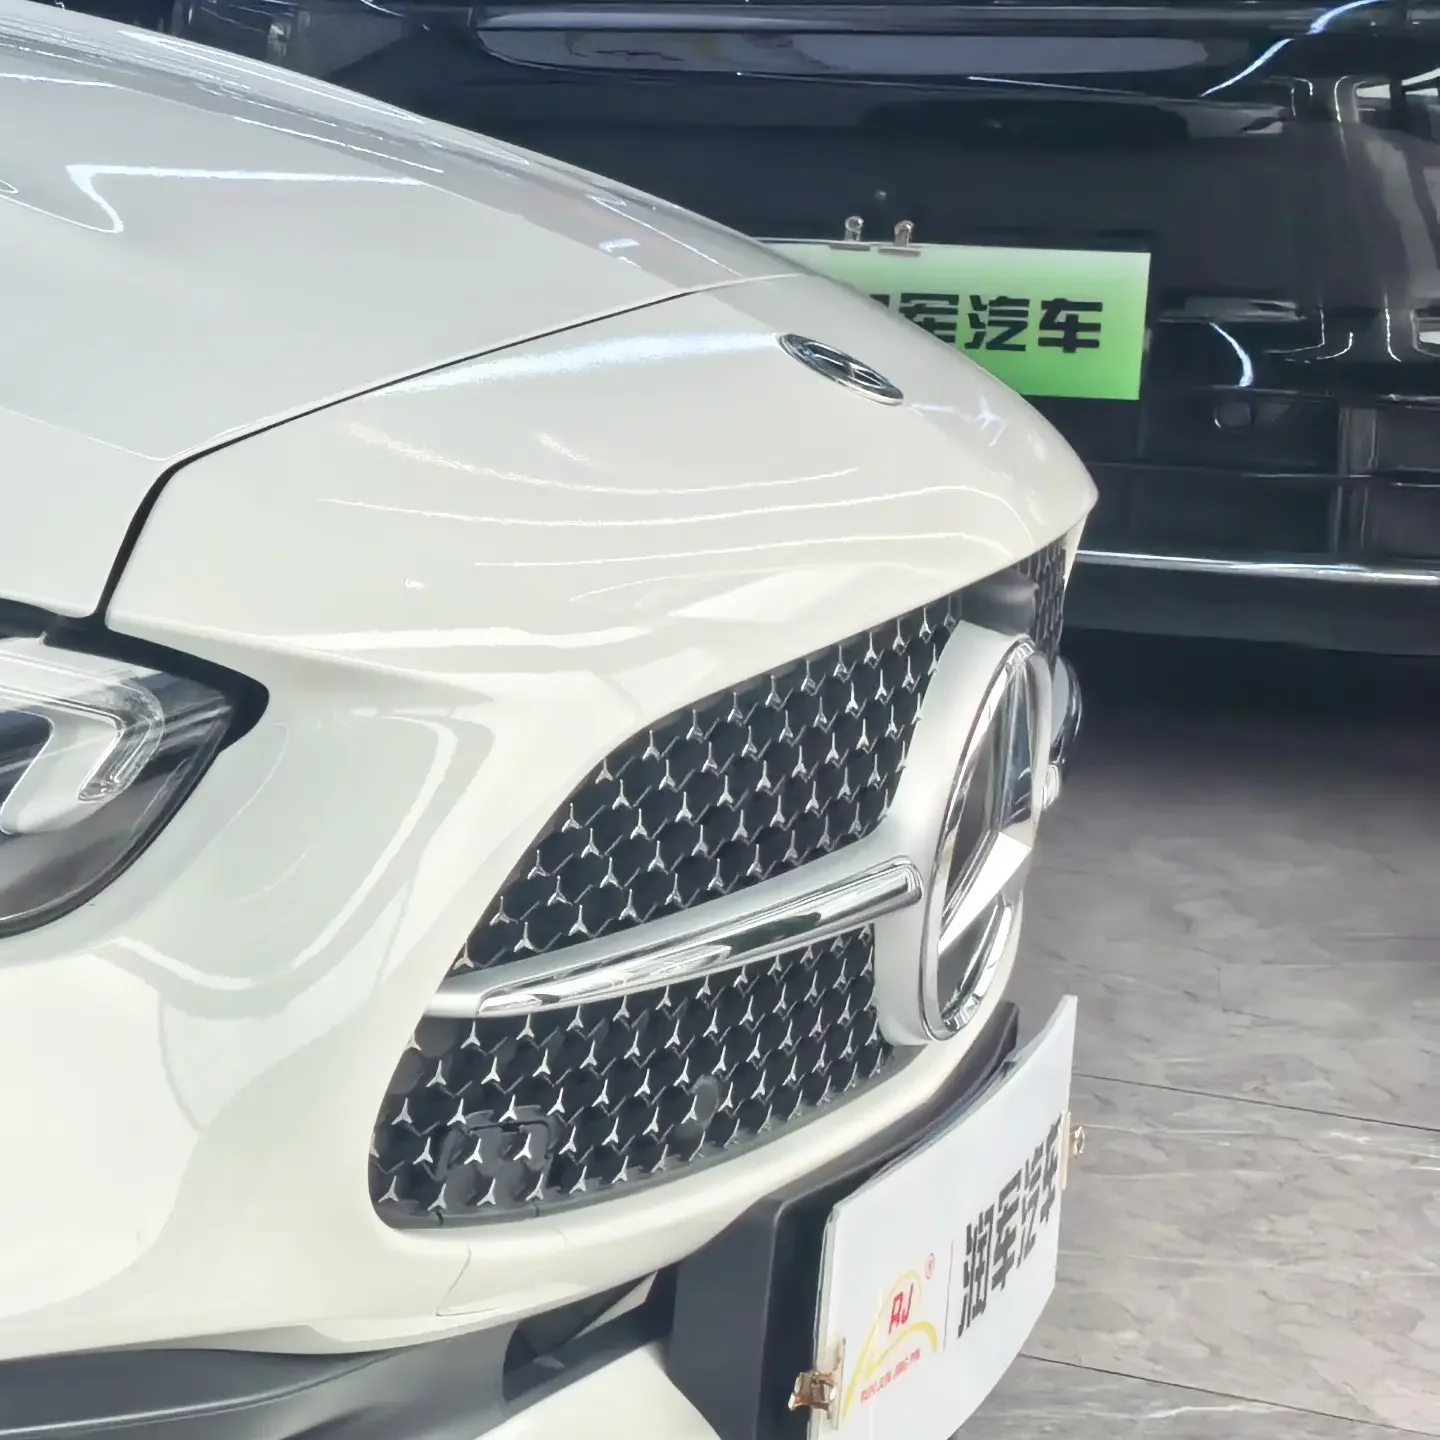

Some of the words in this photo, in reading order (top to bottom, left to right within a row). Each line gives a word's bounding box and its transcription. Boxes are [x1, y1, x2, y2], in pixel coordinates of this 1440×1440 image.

[869, 292, 1104, 354] 军汽车
[957, 1113, 1062, 1339] 润军汽车
